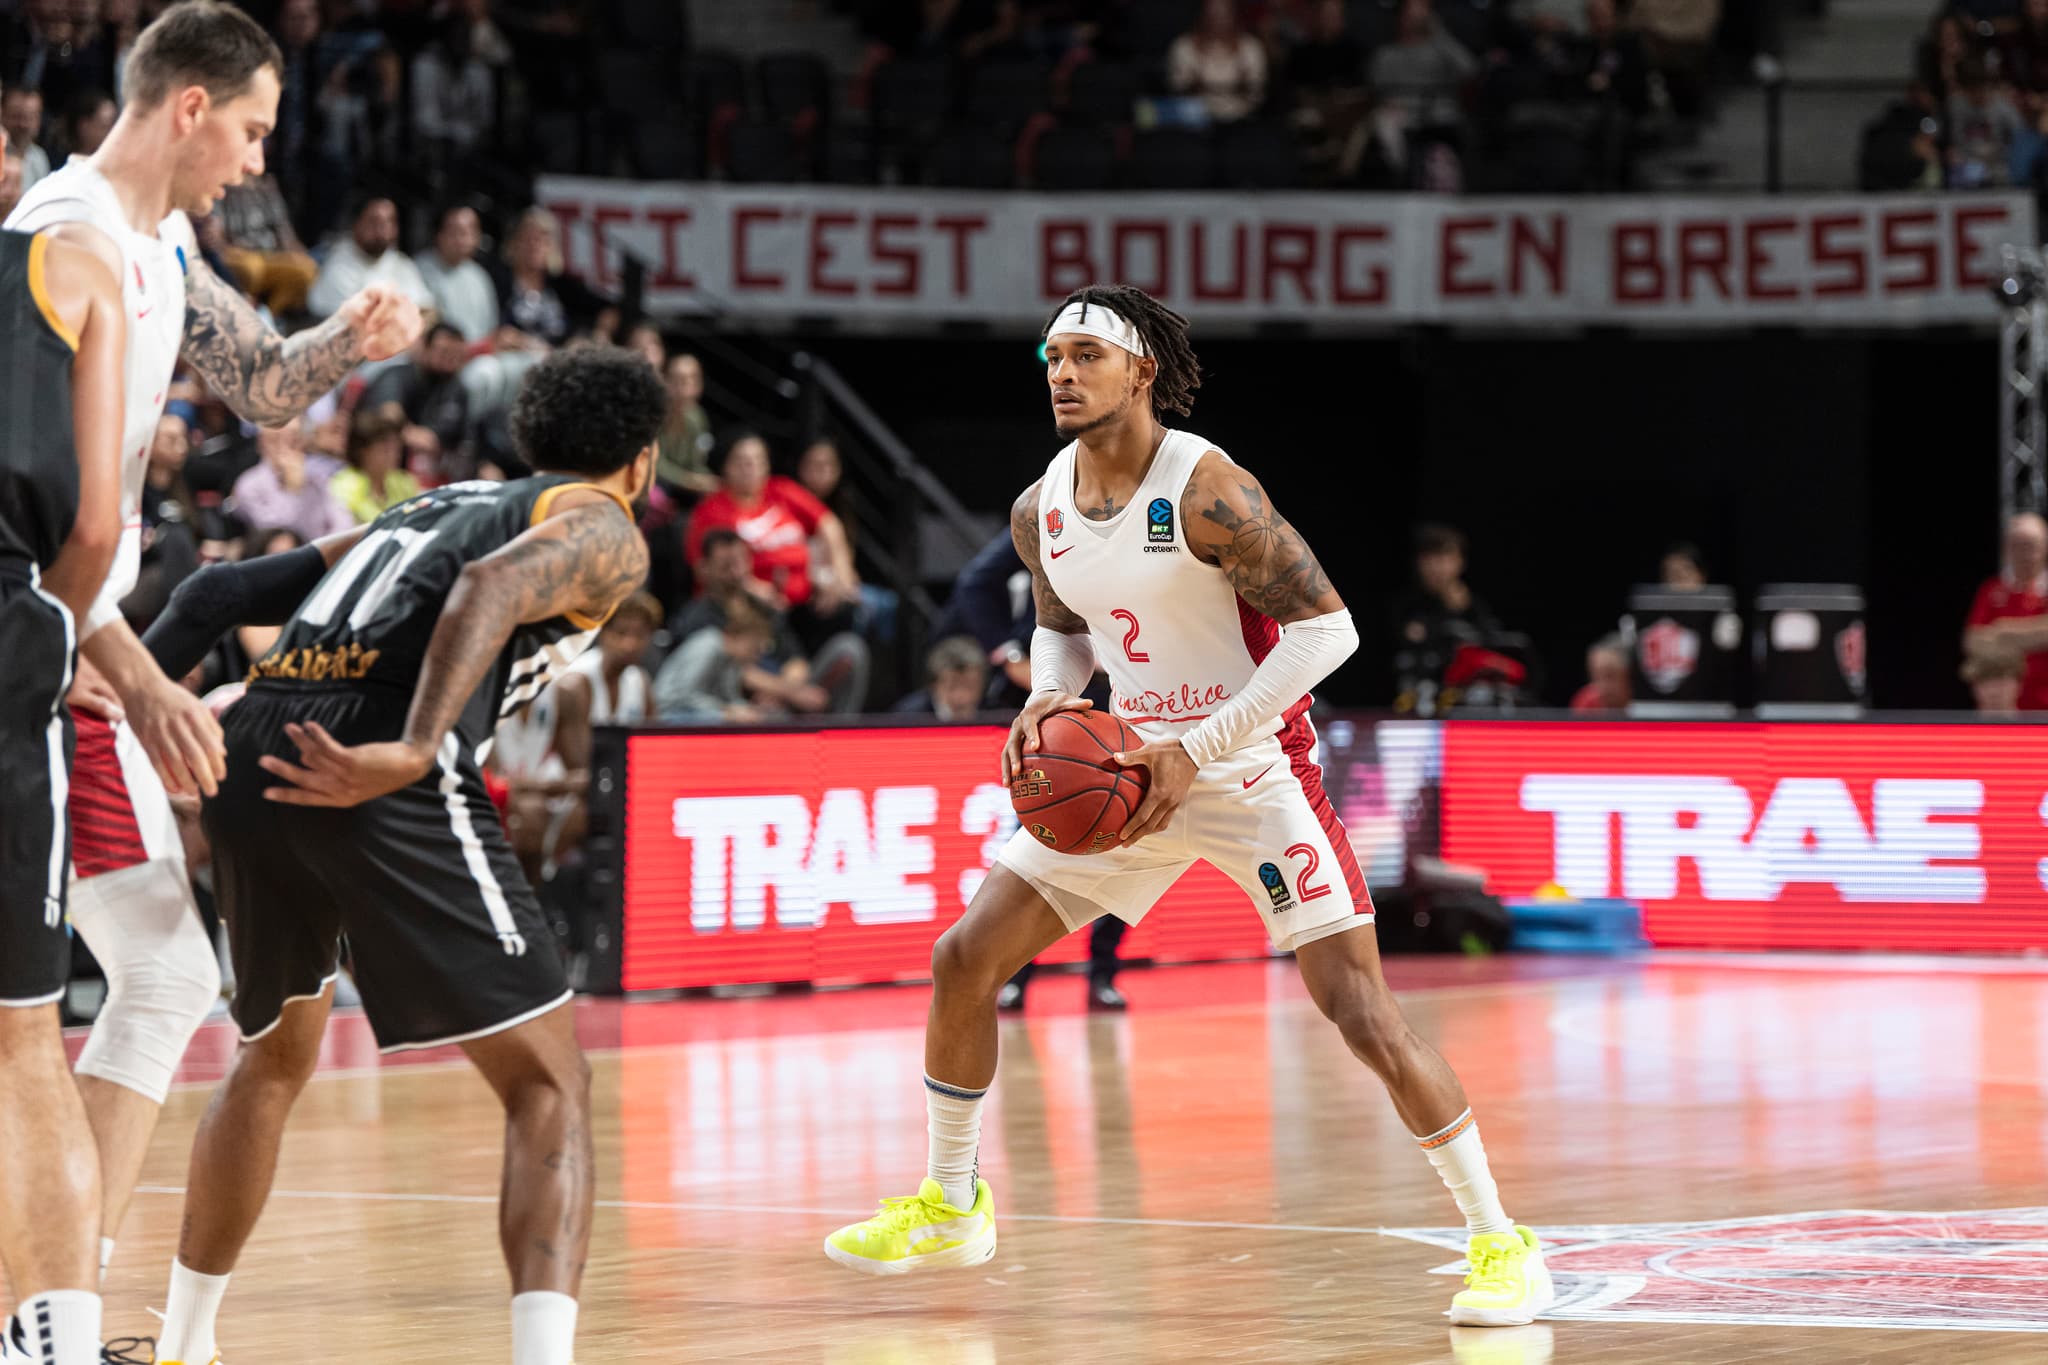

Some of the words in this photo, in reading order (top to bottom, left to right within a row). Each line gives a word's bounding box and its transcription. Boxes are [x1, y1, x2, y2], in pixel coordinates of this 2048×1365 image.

[731, 206, 988, 297] C'EST
[1038, 218, 1391, 303] BOURG
[1439, 212, 1567, 298] EN
[1610, 207, 2011, 302] BRESSE
[1143, 545, 1180, 553] oneteam
[1110, 608, 1151, 663] 2
[673, 786, 939, 934] TRAE
[1283, 842, 1333, 904] 2
[1519, 773, 1987, 904] TRAE
